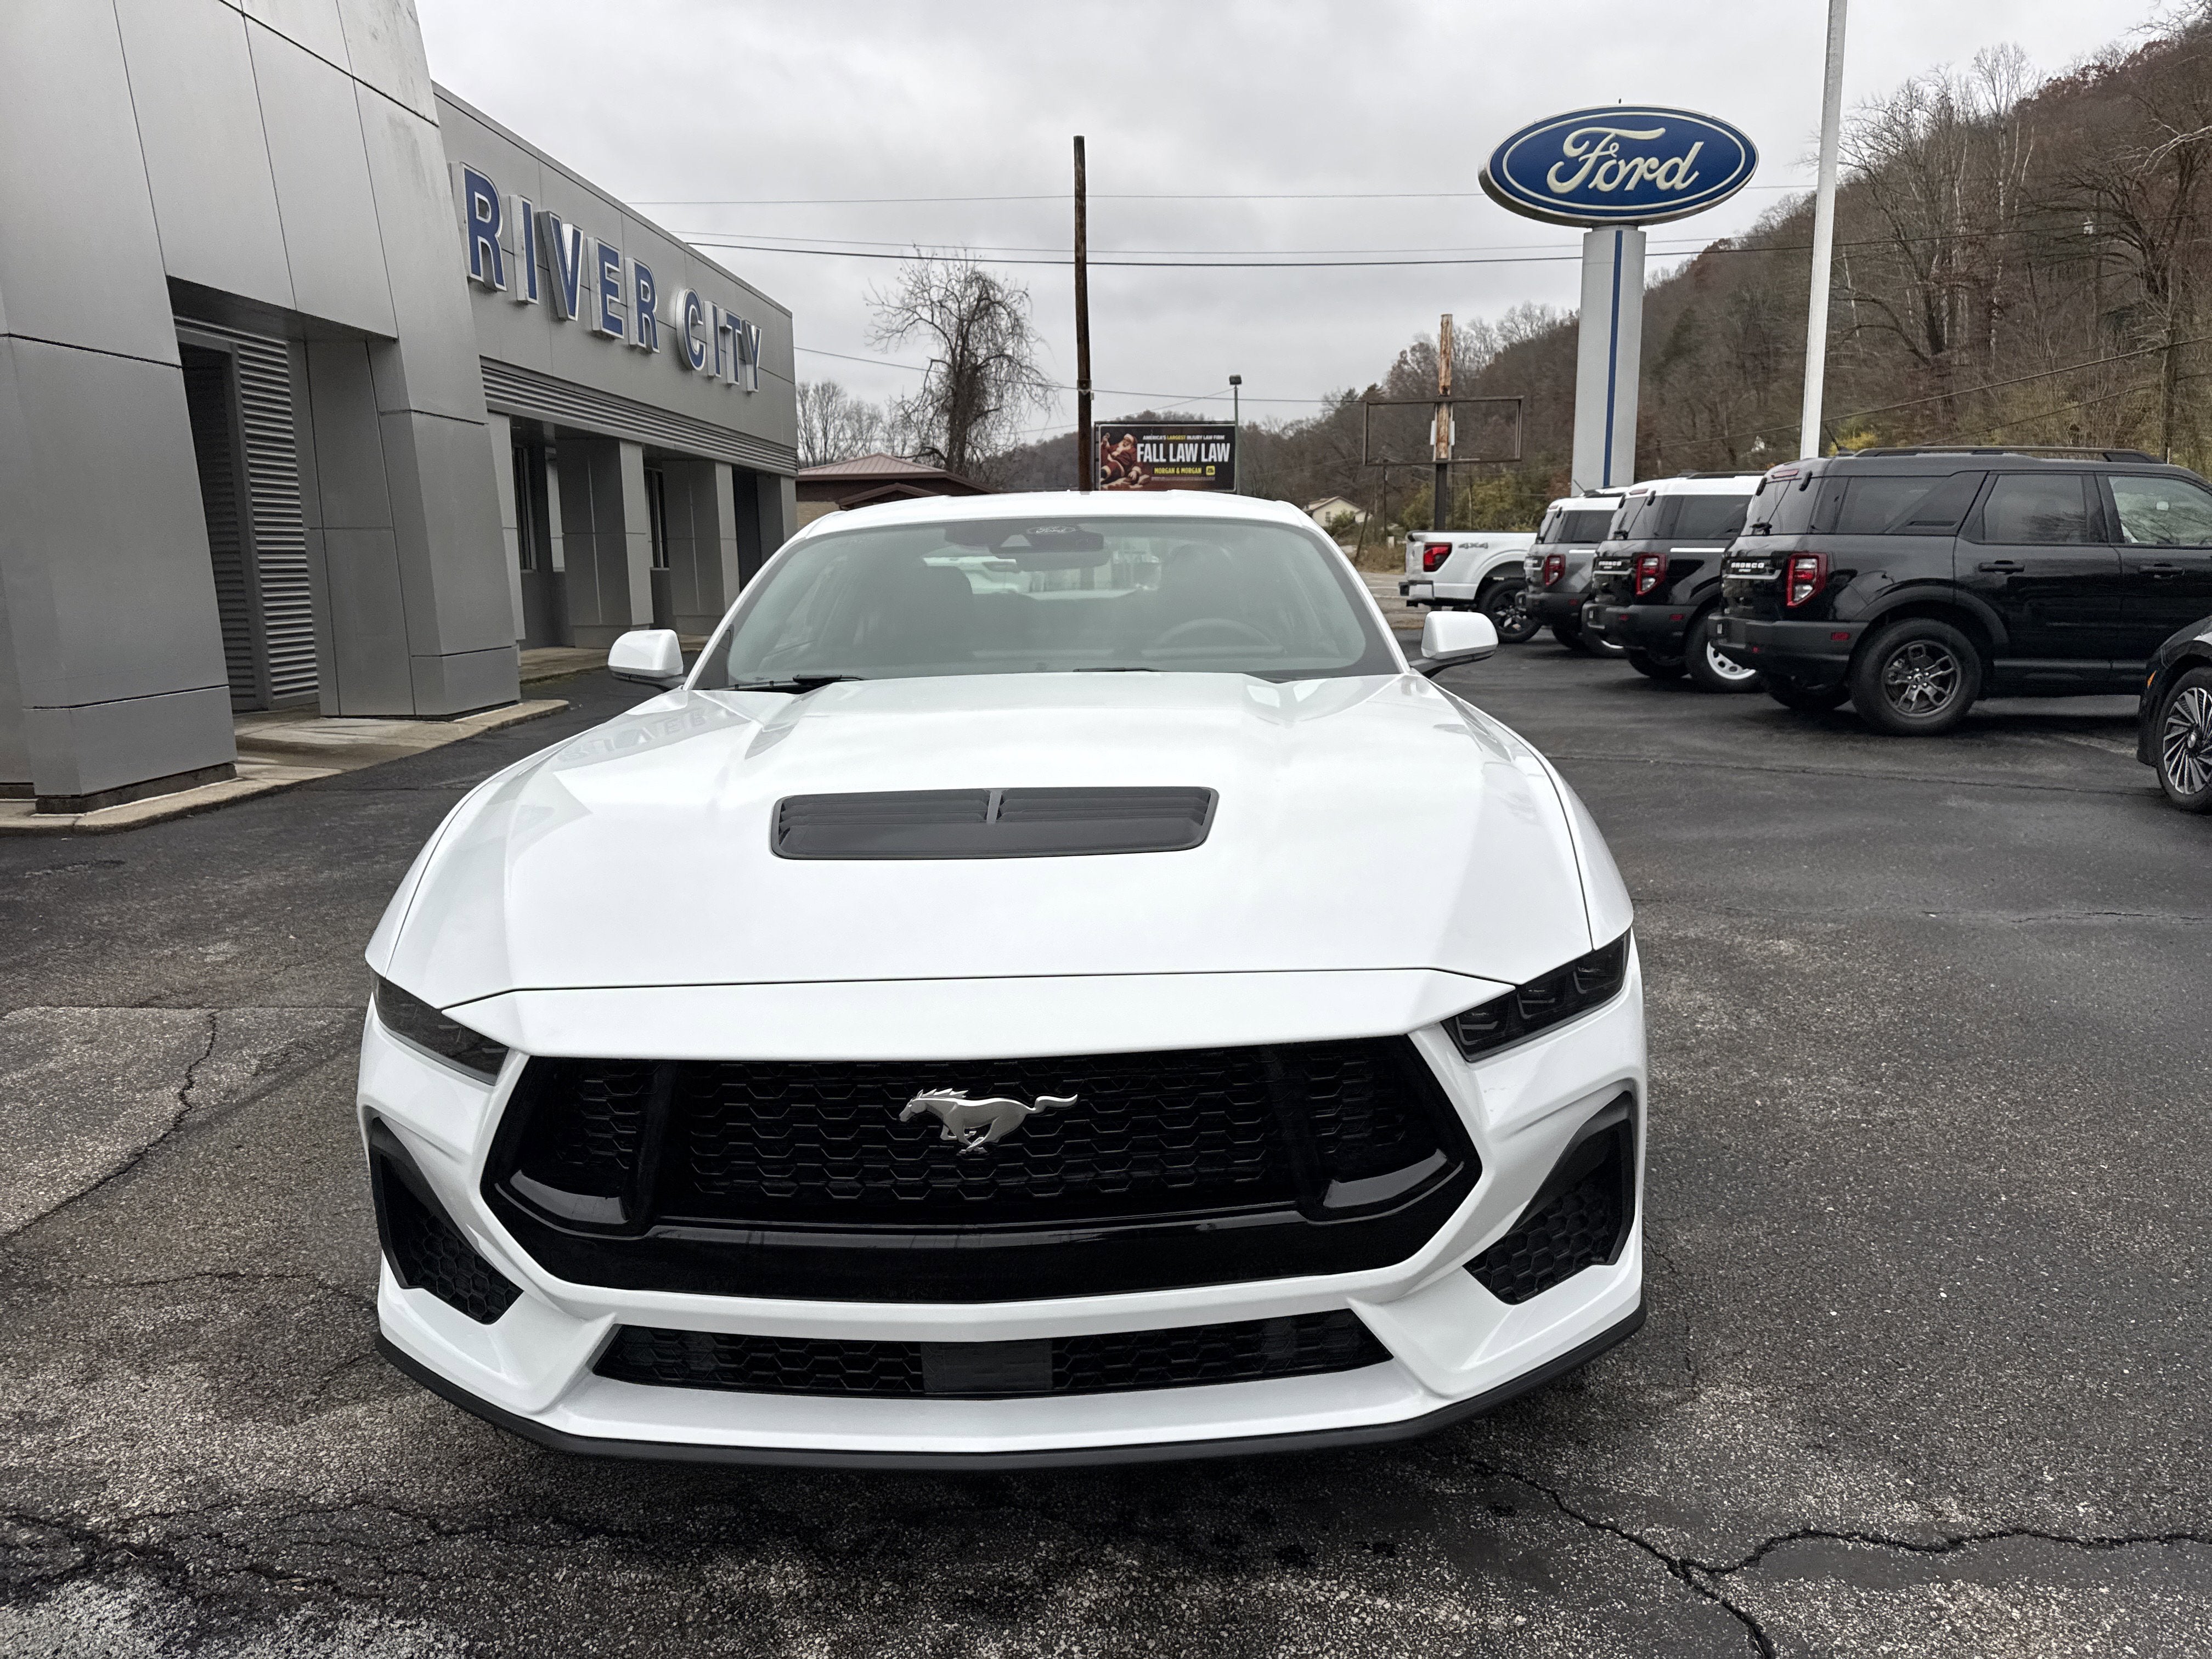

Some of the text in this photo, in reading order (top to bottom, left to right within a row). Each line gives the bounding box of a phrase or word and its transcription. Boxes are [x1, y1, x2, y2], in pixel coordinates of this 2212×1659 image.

[1547, 127, 1704, 193] Ford
[454, 161, 762, 393] RIVER CITY
[1137, 443, 1231, 462] FALL LAW LAW
